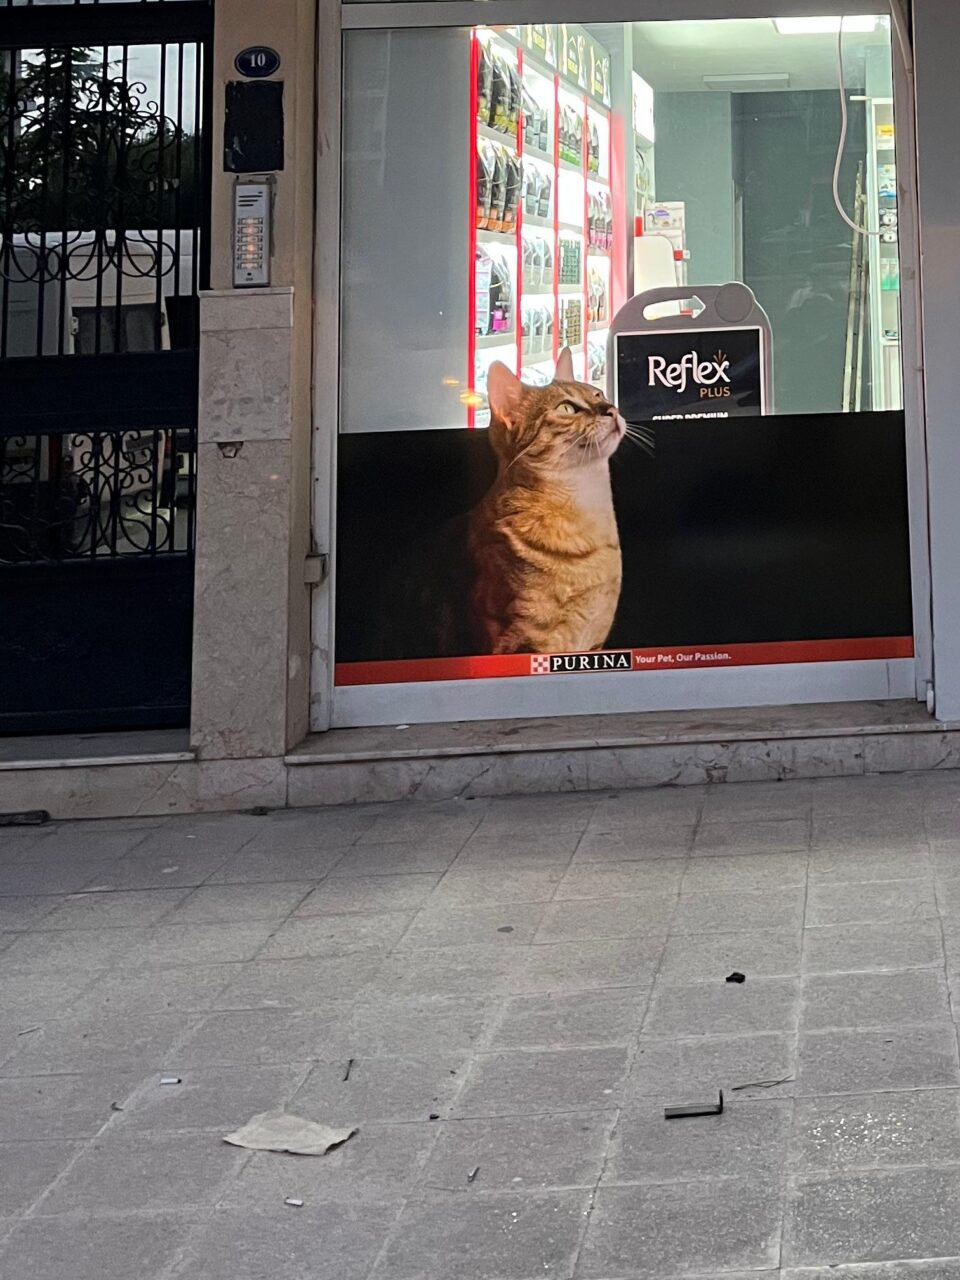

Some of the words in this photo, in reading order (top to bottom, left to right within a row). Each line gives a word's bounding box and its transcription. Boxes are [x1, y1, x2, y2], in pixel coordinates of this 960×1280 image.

[250, 53, 266, 67] 10
[647, 350, 732, 393] Reflex
[699, 386, 731, 398] PLUS
[552, 654, 629, 670] PURINA
[635, 655, 655, 664] Your
[657, 654, 675, 663] Pet,
[676, 653, 693, 662] Our
[695, 652, 732, 661] Passion.
